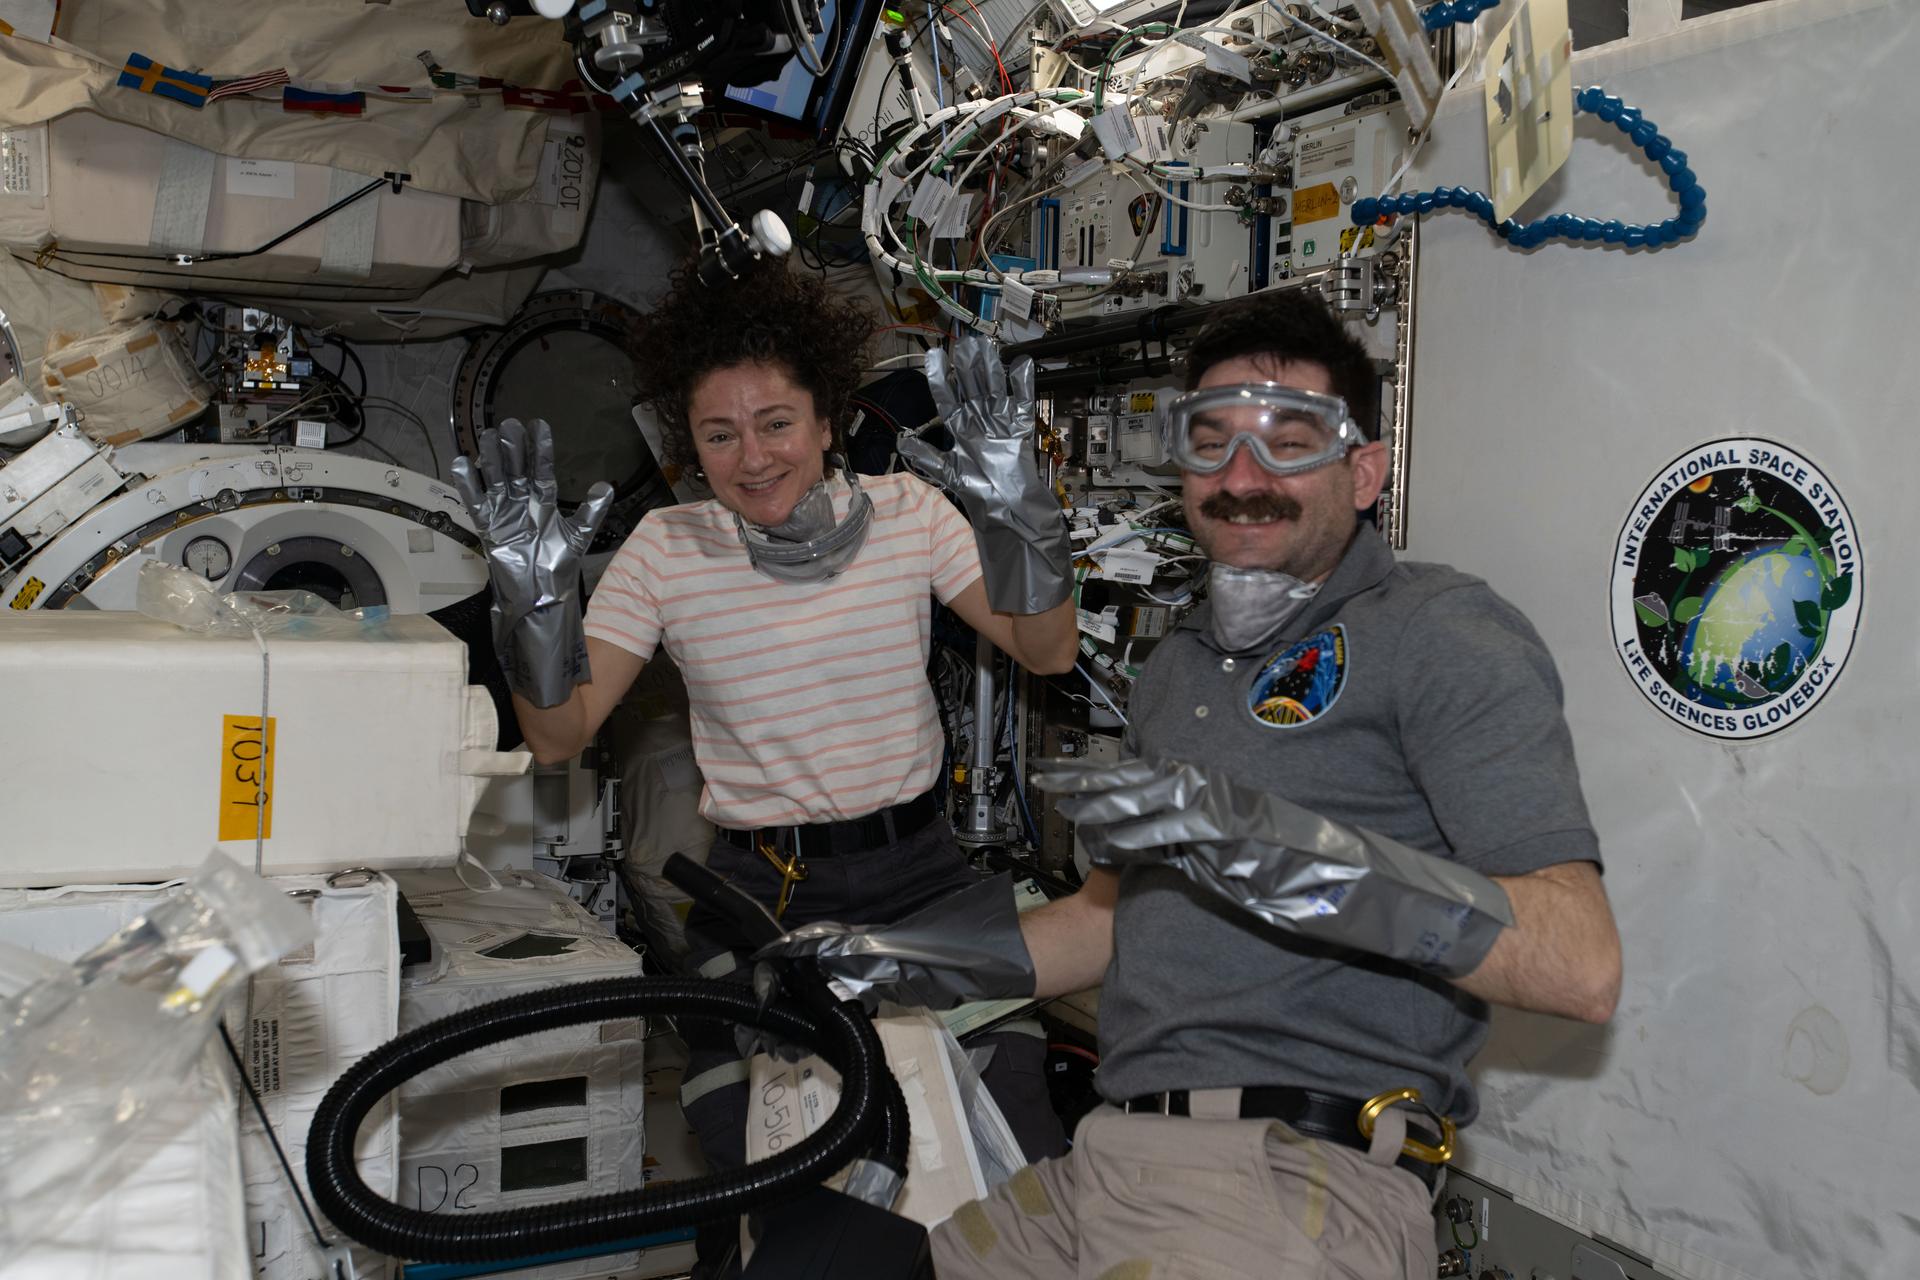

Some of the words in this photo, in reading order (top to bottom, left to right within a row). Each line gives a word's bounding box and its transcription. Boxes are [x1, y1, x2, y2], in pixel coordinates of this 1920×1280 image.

[1301, 140, 1322, 152] MERLIN
[86, 355, 150, 398] 0014
[1622, 449, 1741, 567] INTERNATIONAL
[1748, 449, 1808, 486] SPACE
[1808, 482, 1855, 577] STATION
[1623, 638, 1652, 682] LIFE
[1649, 680, 1738, 732] SCIENCES
[1743, 655, 1836, 731] GLOVEBOX
[231, 724, 269, 806] 1039
[252, 1018, 260, 1037] FOUR
[261, 1020, 270, 1037] LEFT
[252, 1050, 260, 1064] ONE
[262, 1050, 270, 1068] MUST
[253, 1066, 261, 1087] LEAST
[262, 1070, 271, 1093] VENTS
[272, 1067, 281, 1091] CLEAR
[418, 1165, 479, 1213] D2
